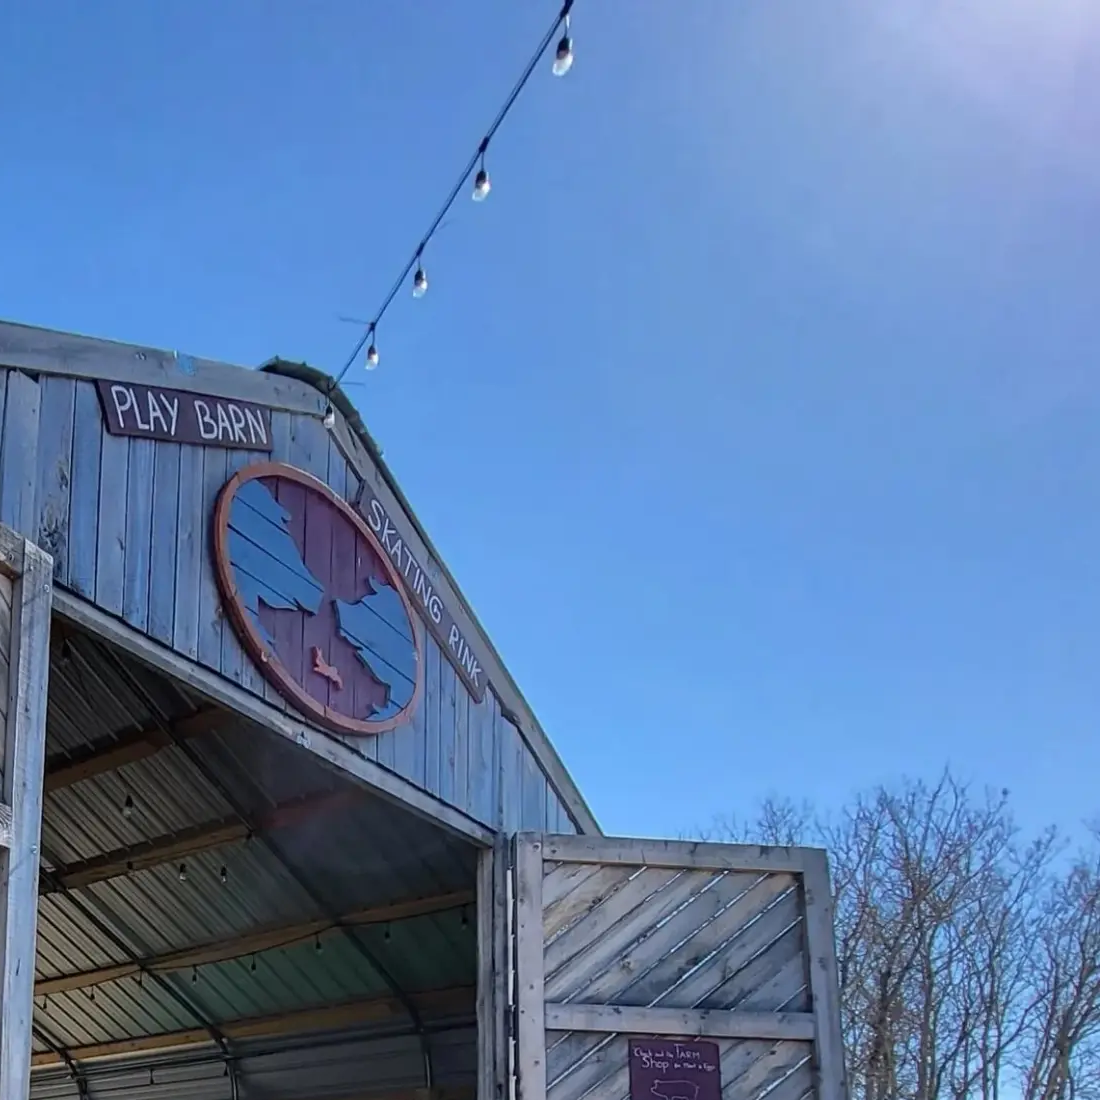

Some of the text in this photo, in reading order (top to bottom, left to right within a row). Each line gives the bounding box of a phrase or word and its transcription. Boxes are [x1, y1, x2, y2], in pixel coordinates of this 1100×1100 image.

[111, 385, 268, 445] PLAY BARN
[368, 500, 482, 687] SKATING RINK
[641, 1055, 670, 1074] Shop
